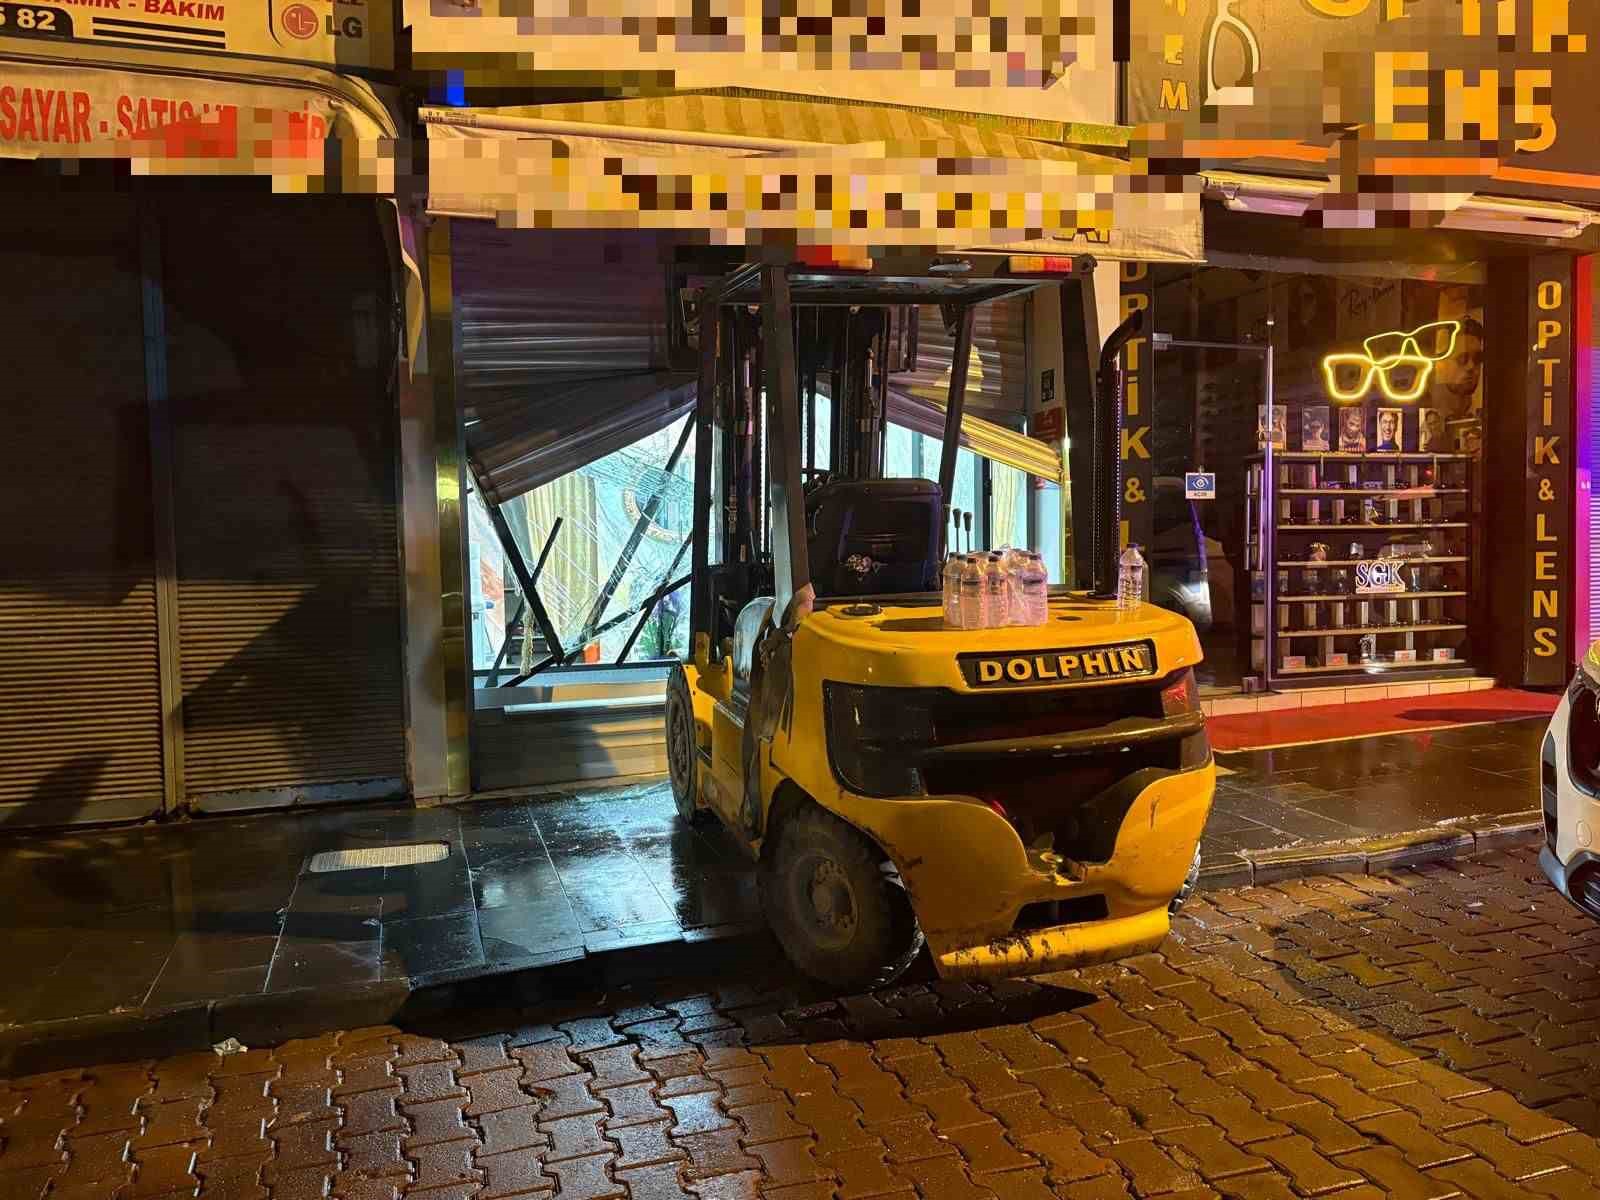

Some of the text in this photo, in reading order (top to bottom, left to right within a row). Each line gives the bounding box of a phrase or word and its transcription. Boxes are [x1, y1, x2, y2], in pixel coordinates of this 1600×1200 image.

[16, 8, 56, 31] 82
[325, 15, 363, 38] LG
[0, 86, 91, 143] SAYAR
[1123, 476, 1146, 502] &
[1538, 478, 1555, 501] &
[1355, 560, 1405, 588] SGK
[1533, 513, 1559, 657] LENS
[978, 649, 1144, 683] DOLPHIN
